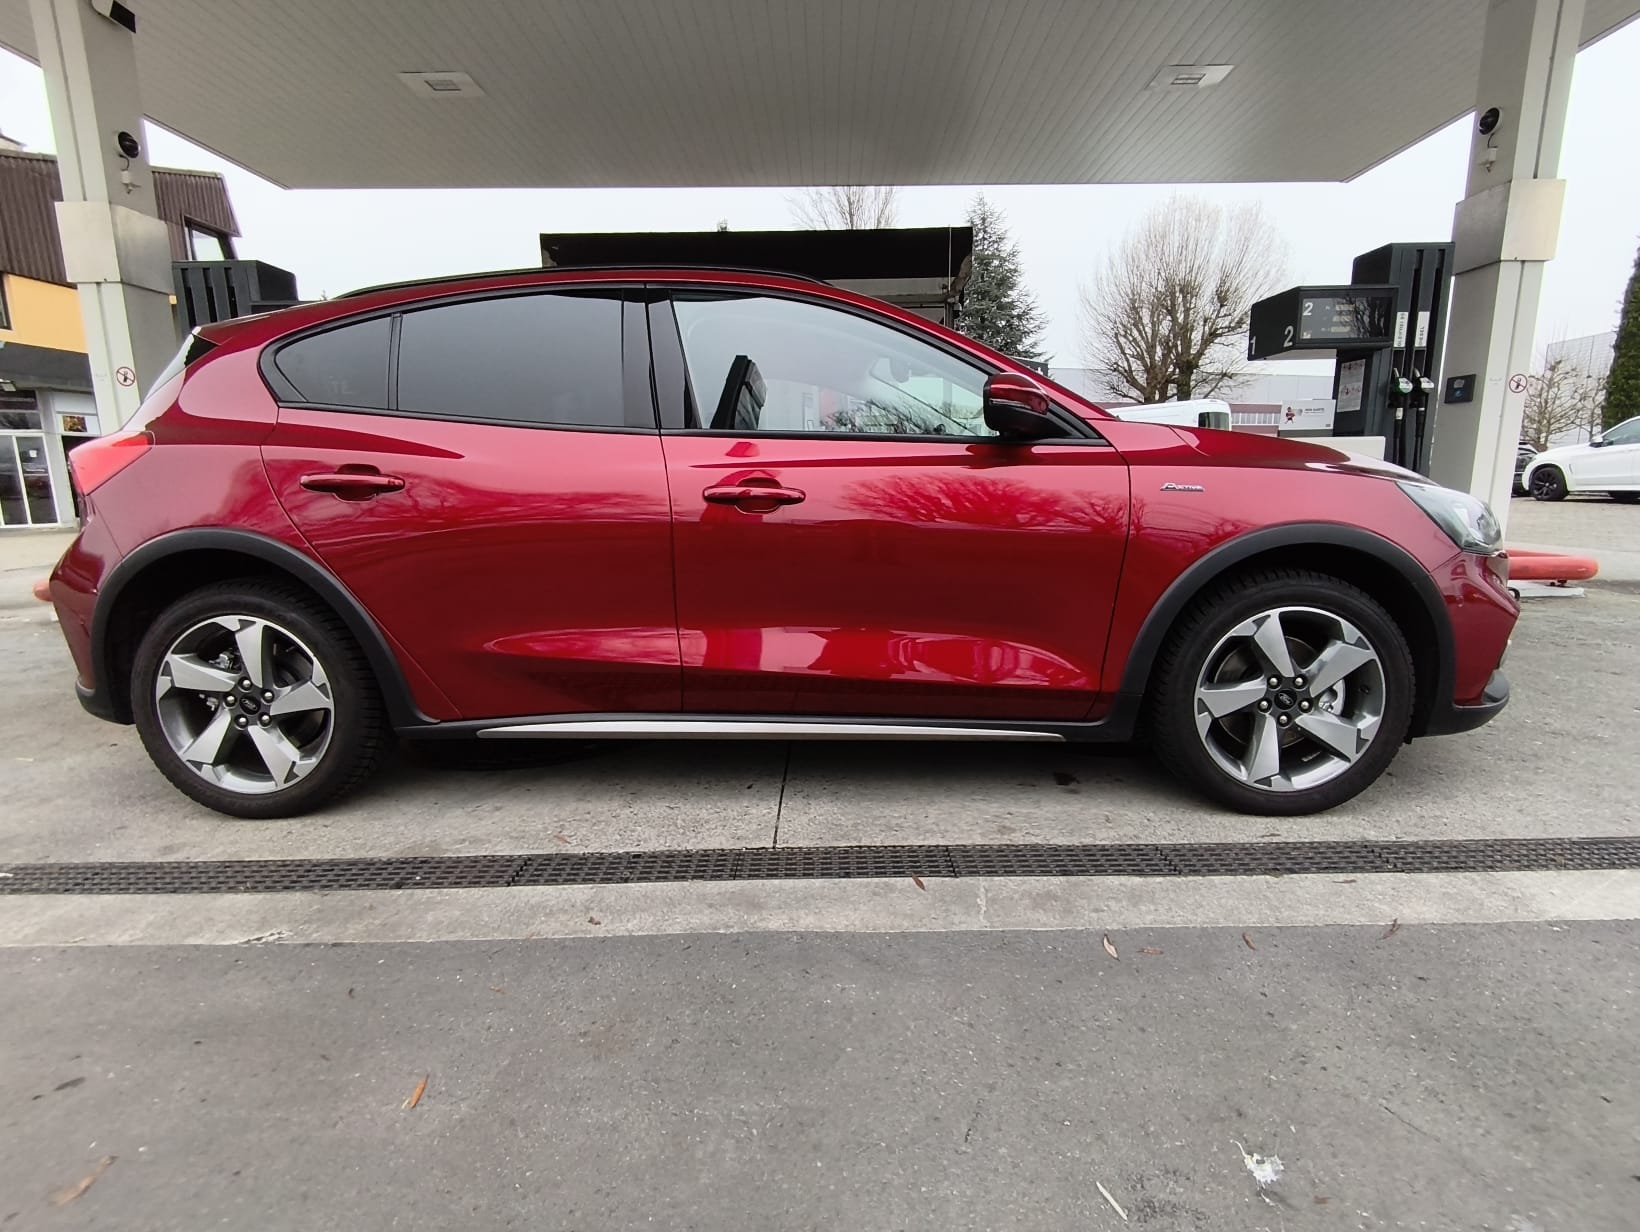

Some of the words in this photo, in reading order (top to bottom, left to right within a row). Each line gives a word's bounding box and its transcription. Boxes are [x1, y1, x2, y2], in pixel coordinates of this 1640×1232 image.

[1302, 302, 1314, 316] 2
[1250, 335, 1256, 355] 1
[1283, 325, 1294, 347] 2
